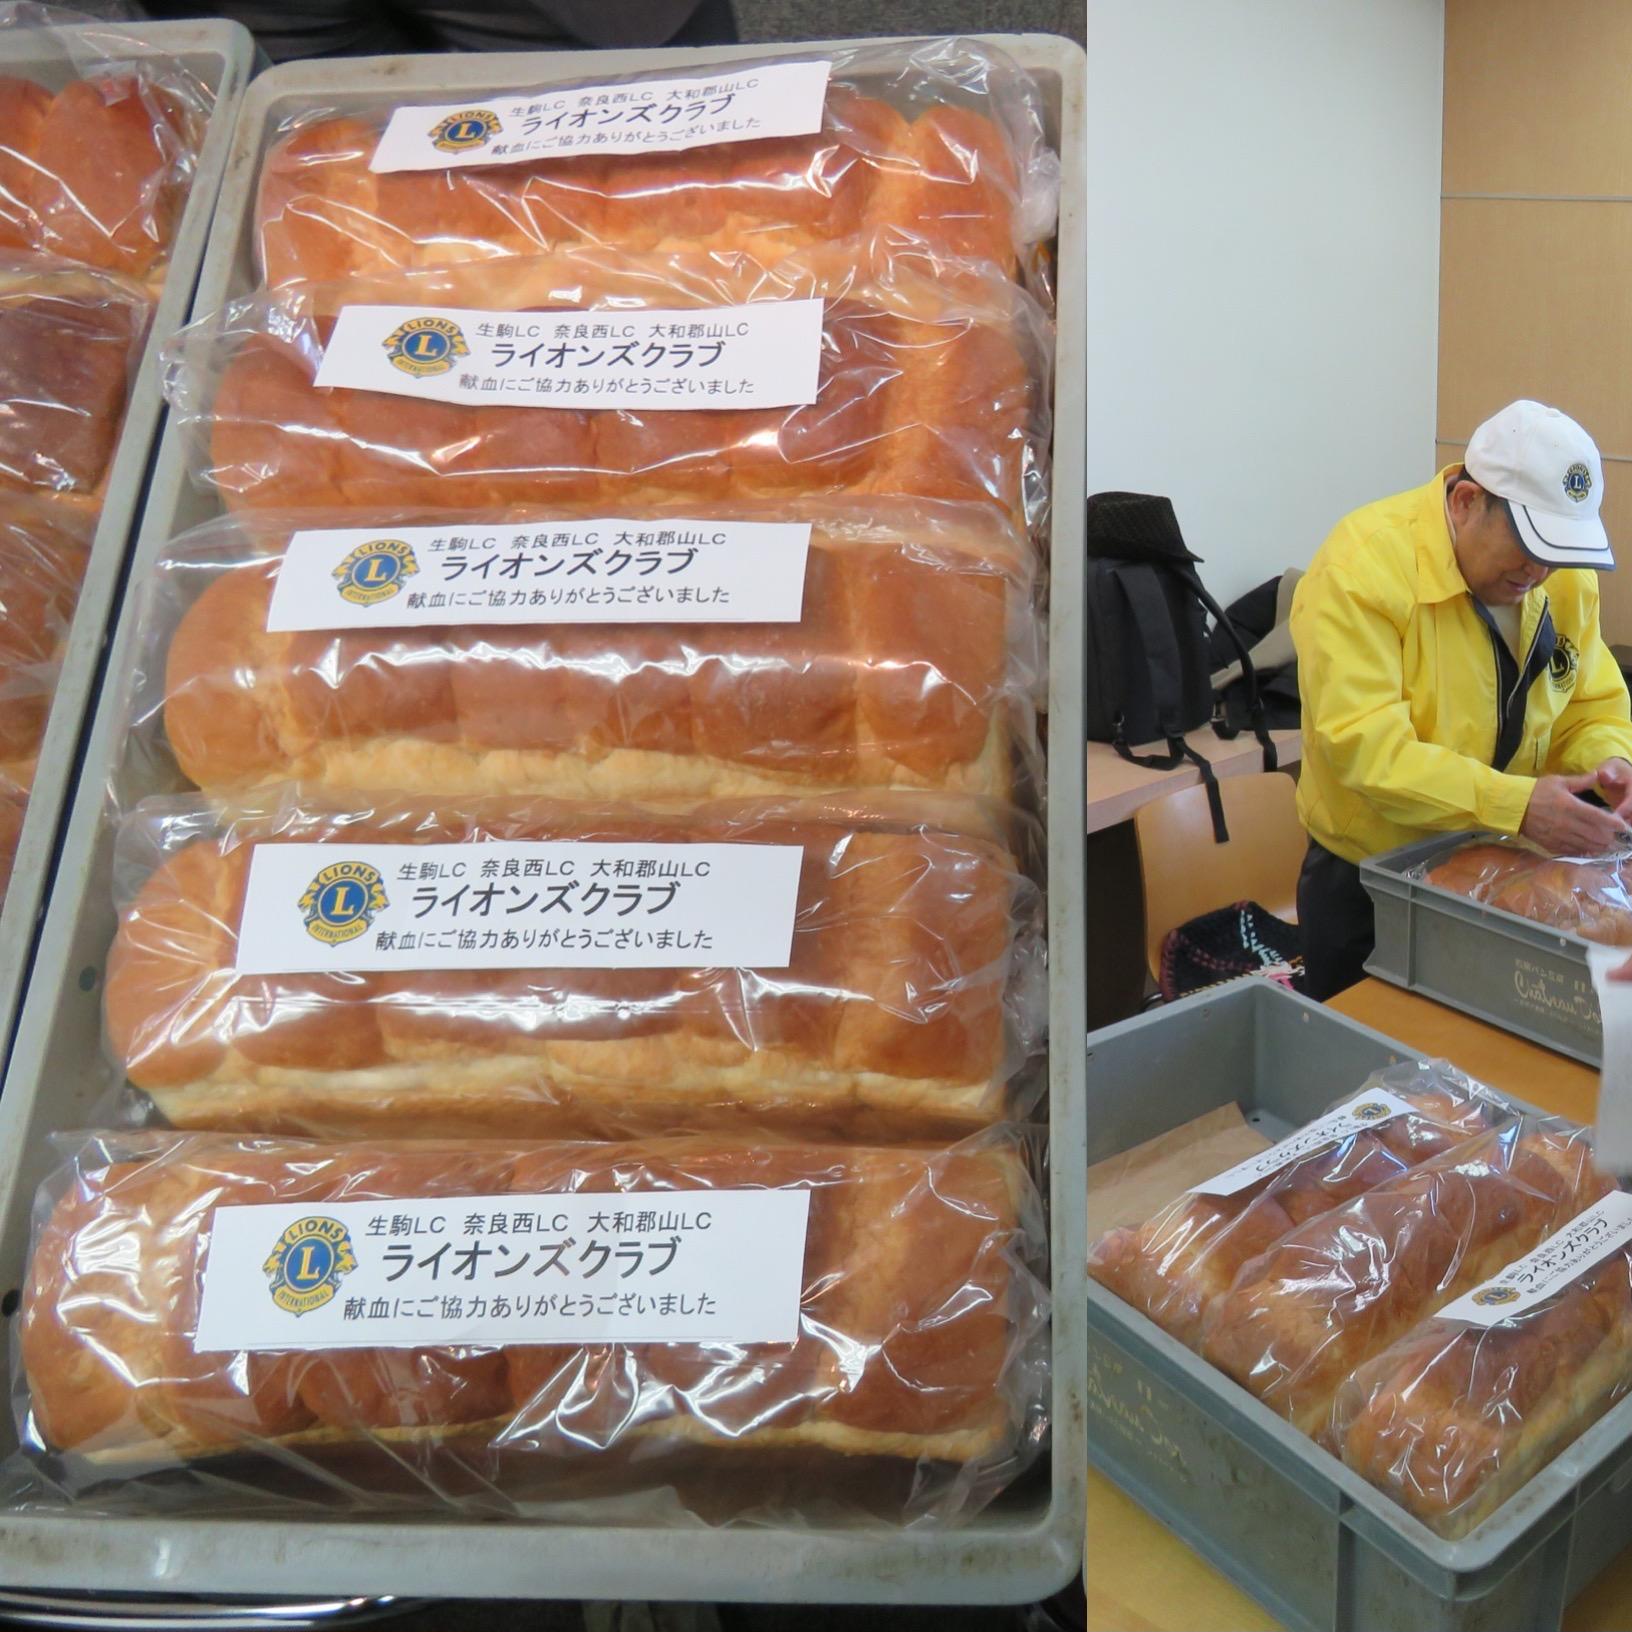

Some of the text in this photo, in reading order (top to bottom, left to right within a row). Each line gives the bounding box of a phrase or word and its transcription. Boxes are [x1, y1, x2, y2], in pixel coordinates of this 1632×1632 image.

[509, 78, 760, 118] 生駒LC 奈良西LC 大和郡山LC
[521, 94, 736, 136] ライオンズクラブ
[457, 123, 477, 139] L
[491, 117, 762, 157] 献血にご協力ありがとうございました
[406, 317, 458, 338] LIONS
[477, 321, 749, 339] 生駒LC 奈良西LC 大和郡山LC
[415, 335, 437, 357] L
[491, 341, 727, 369] ライオンズクラブ
[459, 373, 755, 395] 献血にご協力ありがとうございました
[358, 539, 407, 556] LIONS
[428, 531, 727, 554] 生駒LC 奈良西LC 大和郡山LC
[367, 559, 388, 581] L
[441, 548, 700, 582] ライオンズクラブ
[406, 585, 730, 610] 献血にご協力ありがとうございました
[321, 862, 375, 881] LIONS
[397, 859, 711, 882] 生駒LC 奈良西LC 大和郡山LC
[331, 887, 355, 917] L
[412, 880, 682, 919] ライオンズクラブ
[312, 924, 363, 939] INTERNATIONAL
[375, 928, 714, 952] 献血にご協力ありがとうございました
[287, 1217, 345, 1239] LIONS
[365, 1210, 713, 1238] 生駒LC 奈良西LC 大和郡山LC
[297, 1246, 319, 1280] L
[380, 1237, 683, 1282] ライオンズクラブ
[1517, 1217, 1608, 1285] ライオンズクラブ
[278, 1289, 331, 1308] INTERNATIONAL
[343, 1294, 717, 1321] 献血にご協力ありがとうございました
